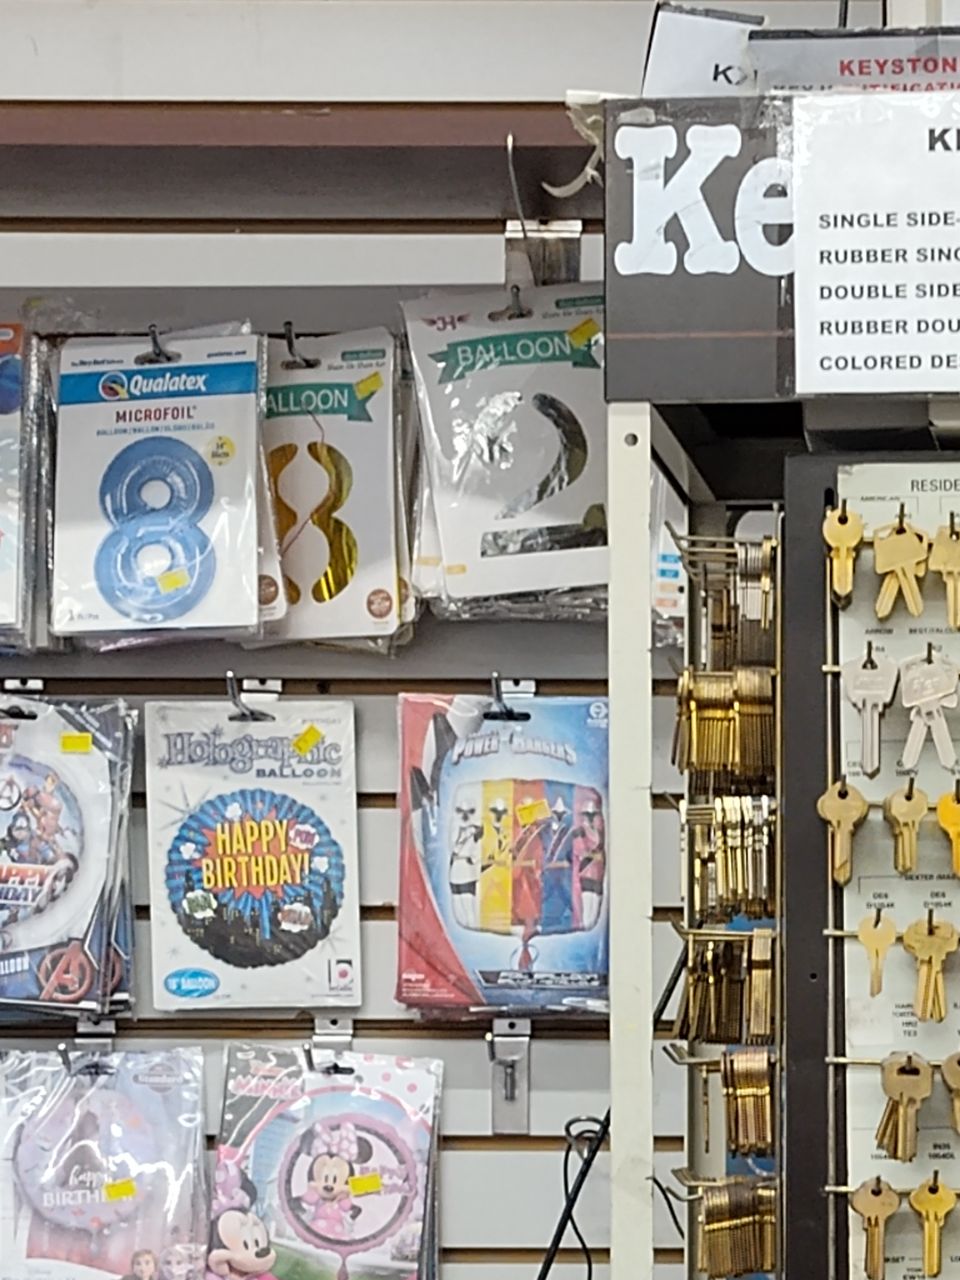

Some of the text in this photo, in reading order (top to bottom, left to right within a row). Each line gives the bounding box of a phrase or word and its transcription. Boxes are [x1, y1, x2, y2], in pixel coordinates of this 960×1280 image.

[614, 123, 795, 276] Ke
[818, 212, 898, 229] SINGLE
[906, 211, 956, 228] SIDE
[818, 248, 908, 265] RUBBER
[819, 284, 907, 301] DOUBLE
[819, 319, 909, 336] RUBBER
[457, 336, 572, 366] BALLOON
[819, 354, 923, 371] COLORED
[129, 373, 207, 395] Qualatex
[266, 388, 349, 413] ALLOON
[255, 768, 342, 778] BALLOON
[215, 818, 289, 856] HAPPY
[201, 852, 310, 889] BIRTHDAY!
